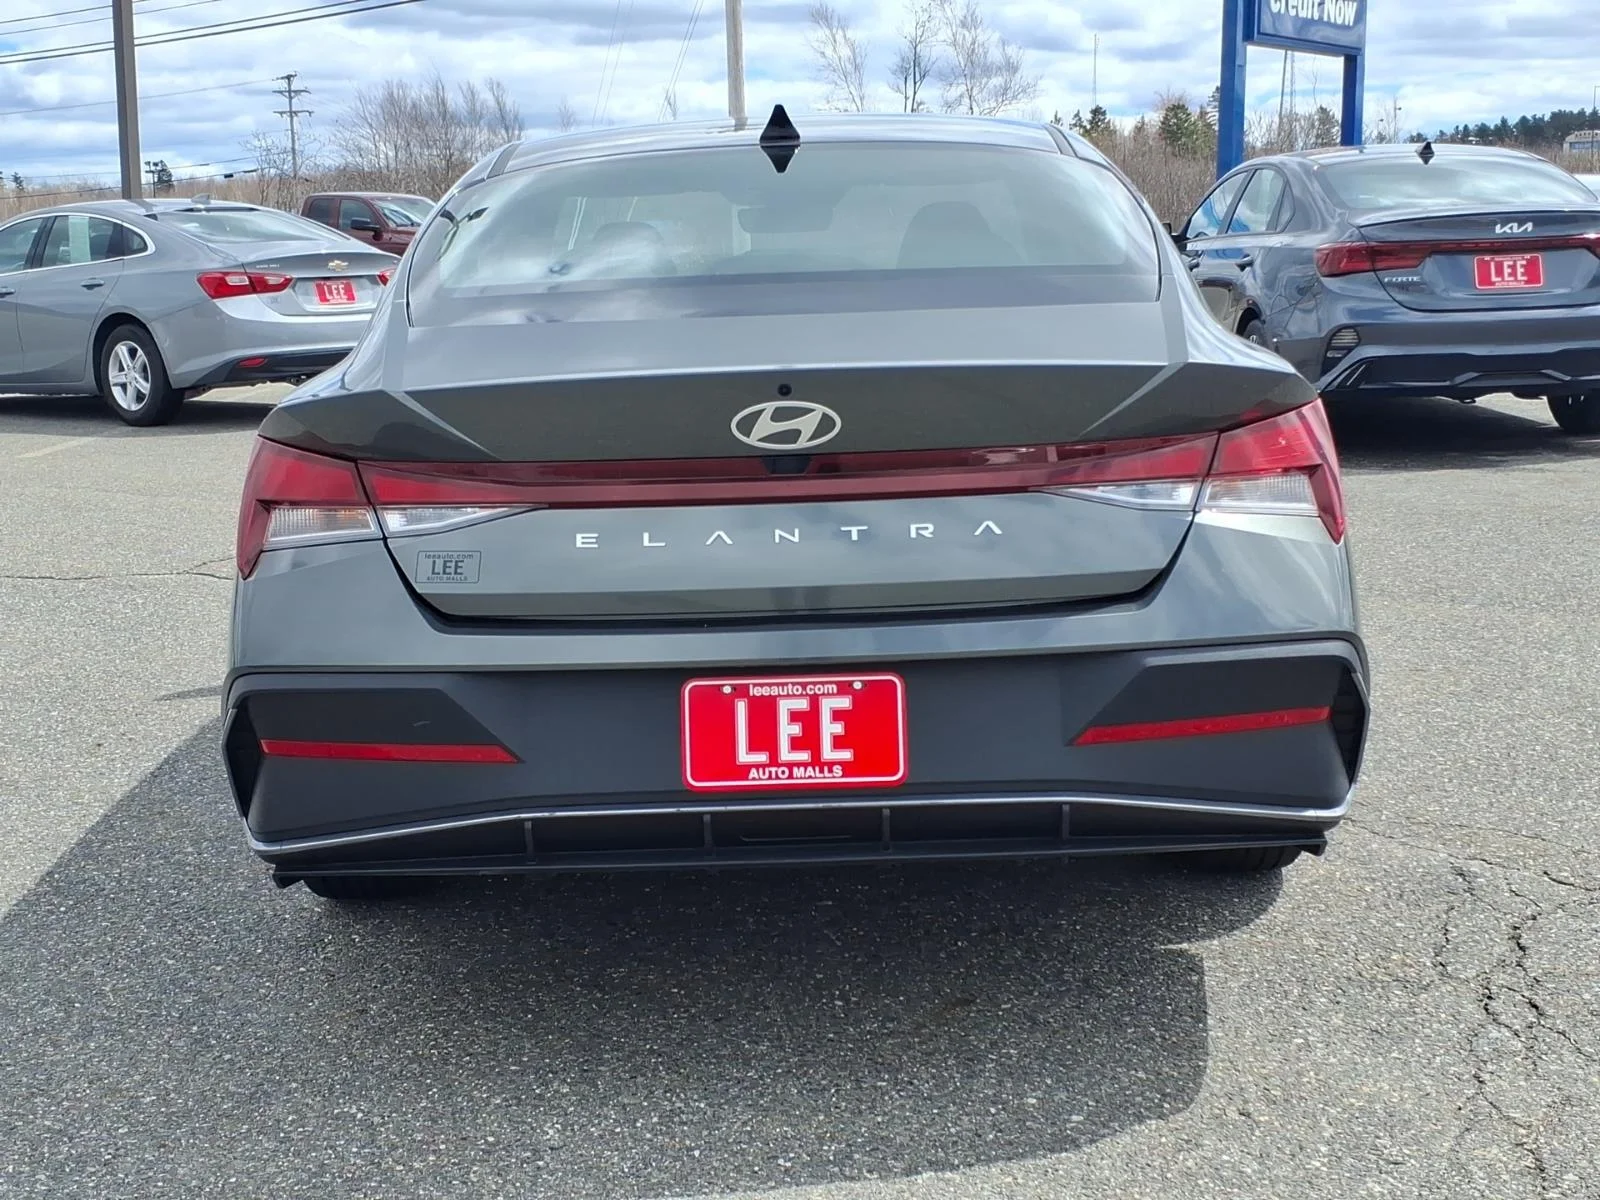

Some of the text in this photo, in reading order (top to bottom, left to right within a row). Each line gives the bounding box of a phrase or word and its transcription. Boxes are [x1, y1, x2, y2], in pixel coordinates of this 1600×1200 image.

[1323, 0, 1357, 26] Now
[1495, 222, 1534, 234] KIA
[1490, 260, 1528, 282] LEE
[324, 284, 348, 300] LEE
[575, 520, 1003, 548] ELANTRA
[431, 559, 465, 576] LEE
[749, 683, 838, 697] leeauto.com
[735, 695, 854, 765] LEE
[748, 764, 843, 780] AUTO MALLS
